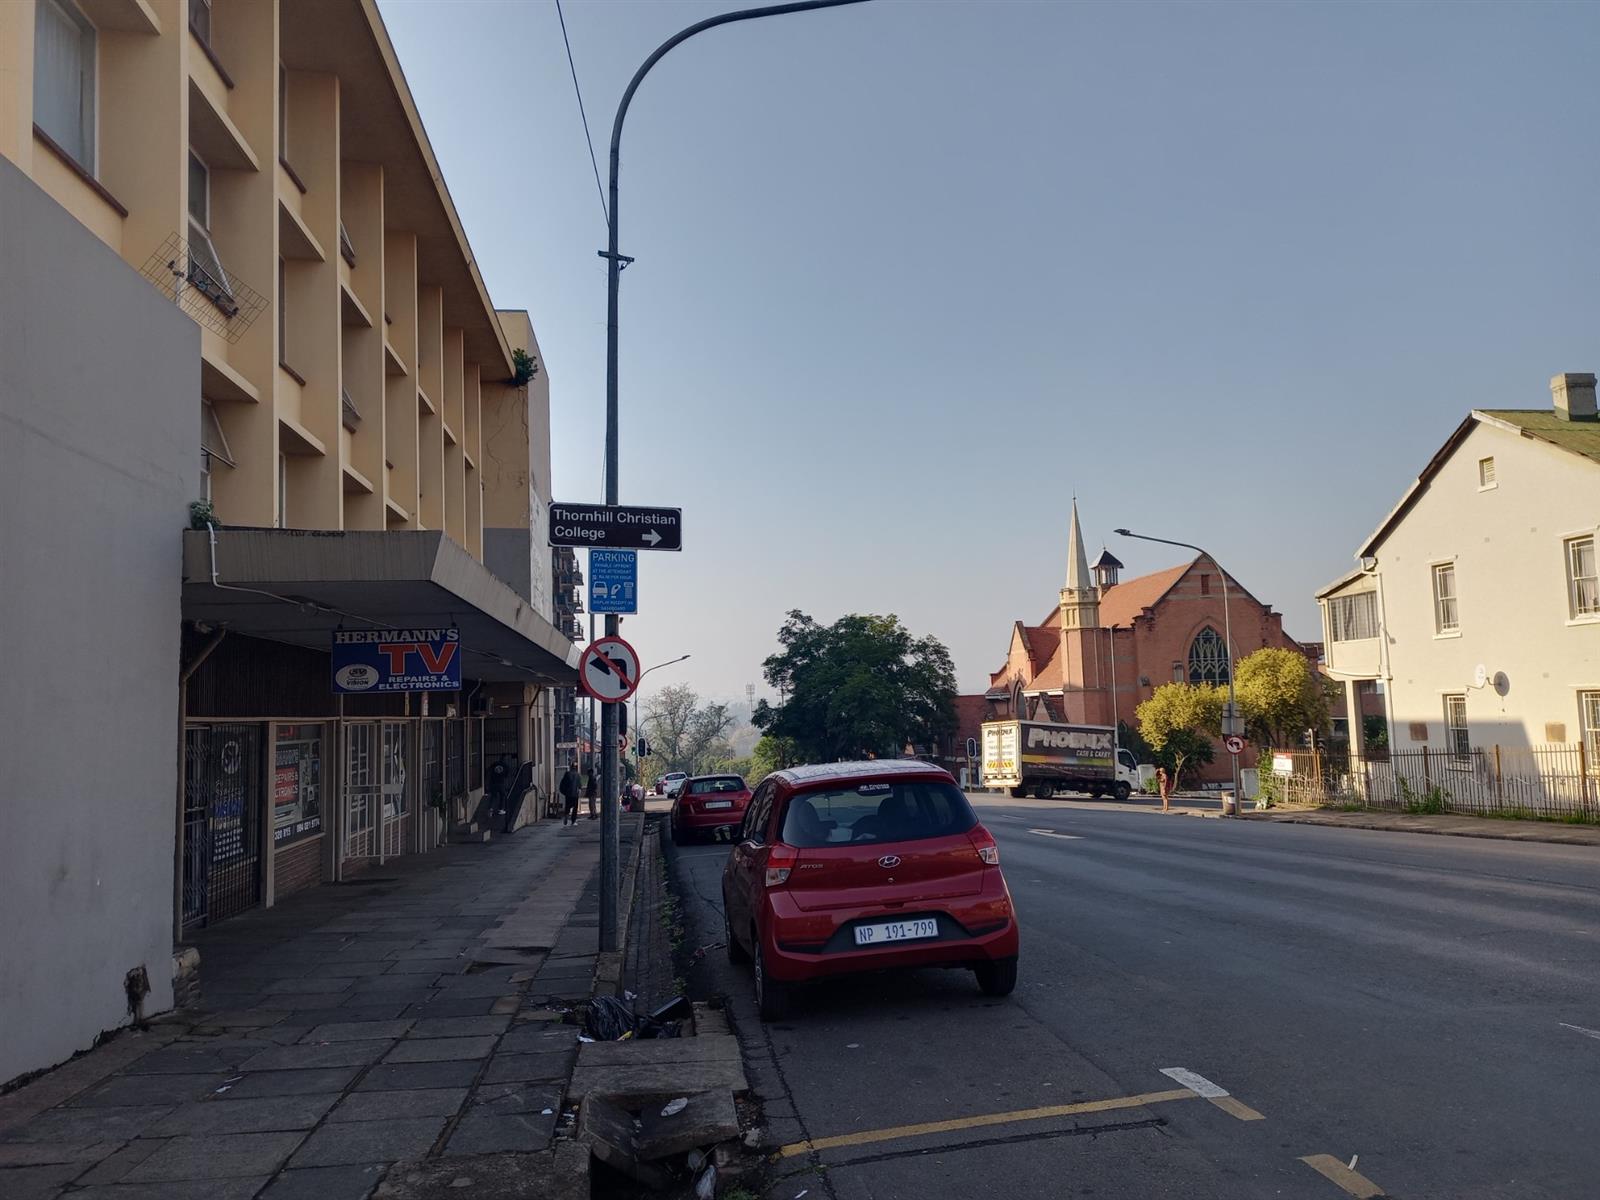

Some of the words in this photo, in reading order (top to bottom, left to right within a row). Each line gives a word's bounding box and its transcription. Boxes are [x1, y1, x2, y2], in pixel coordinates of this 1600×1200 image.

[554, 509, 613, 523] Thornhill
[617, 512, 676, 525] Christian
[554, 526, 606, 541] College
[592, 552, 635, 562] PARKING
[335, 628, 459, 644] HERMANN'S
[378, 642, 459, 676] TV
[378, 681, 459, 690] ELECTRONICS
[388, 675, 437, 683] REPAIRS
[1028, 727, 1113, 749] PHOENIX
[859, 926, 874, 942] NP
[885, 920, 935, 938] 191-799
